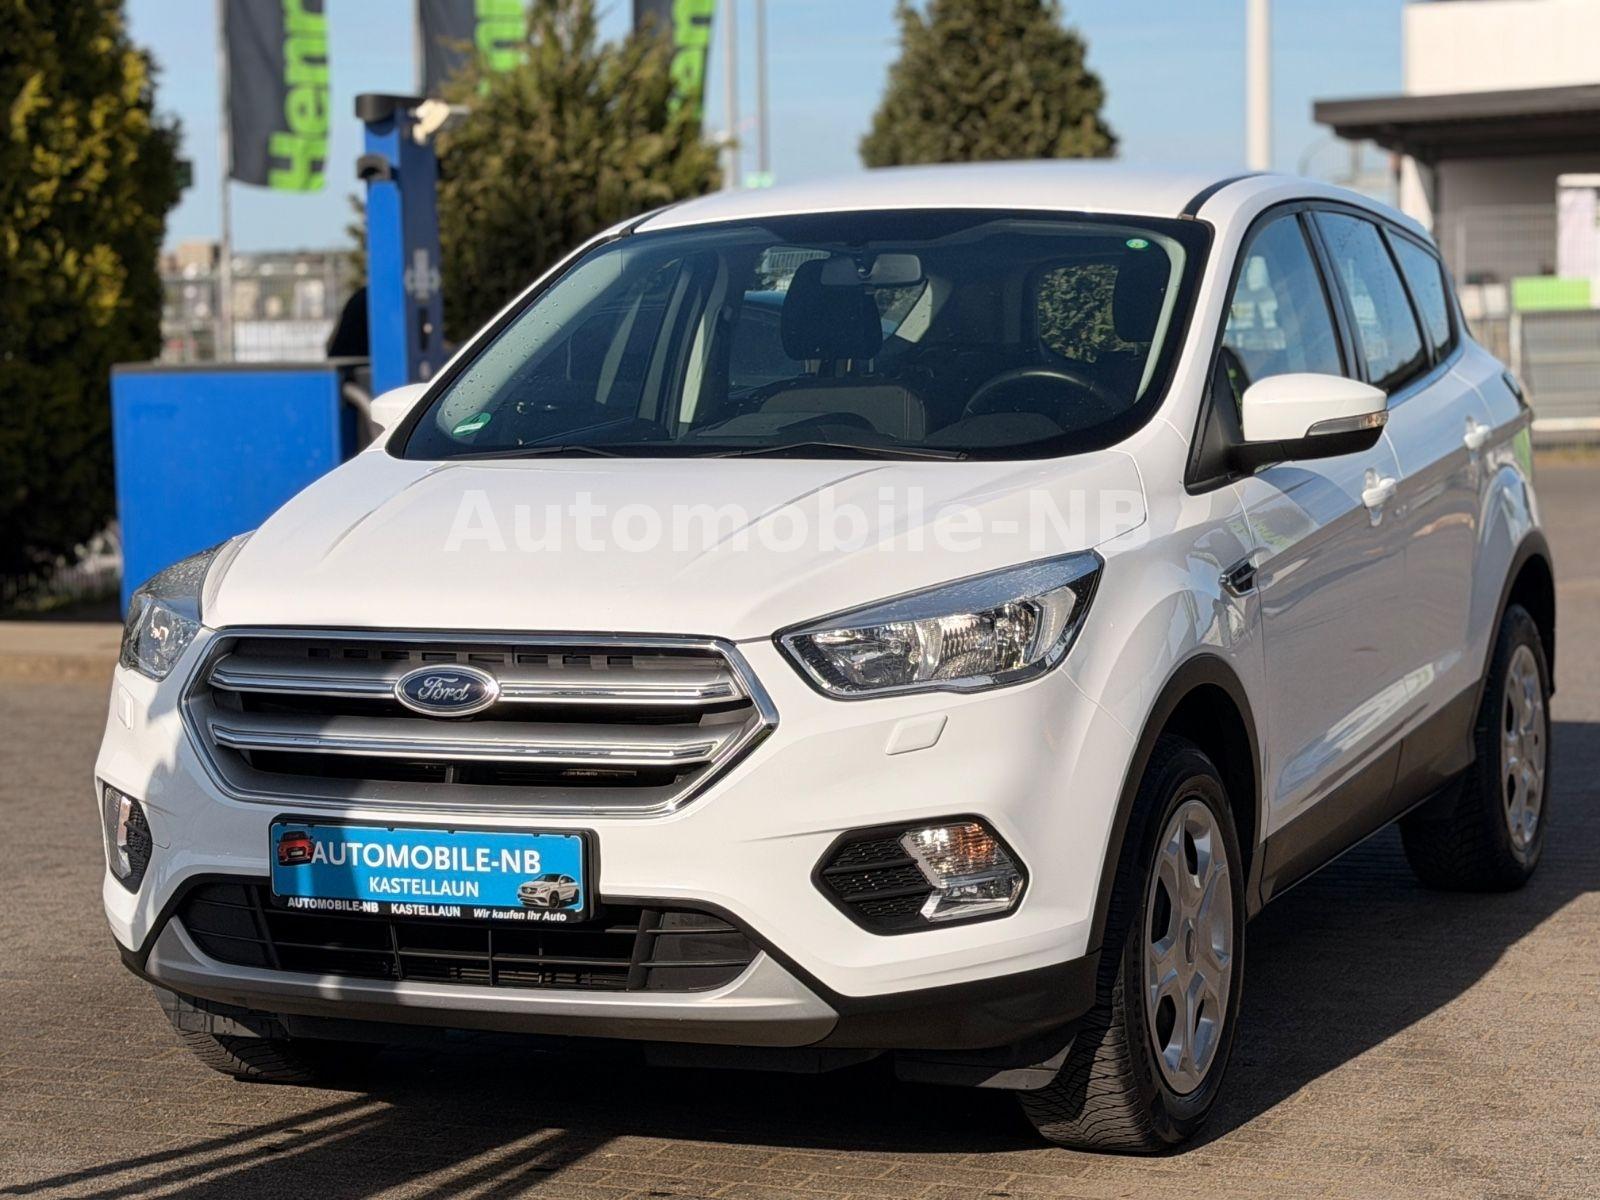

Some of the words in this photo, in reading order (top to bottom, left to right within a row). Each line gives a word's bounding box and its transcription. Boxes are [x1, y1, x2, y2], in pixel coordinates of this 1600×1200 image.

[418, 676, 471, 701] Ford
[311, 841, 541, 874] AUTOMOBILE-NB
[369, 876, 479, 898] KASTELLAUN
[288, 897, 379, 913] AUTOMOBILE-NB
[391, 903, 461, 917] KASTELLAUN
[473, 908, 489, 918] Wir
[491, 909, 525, 920] kaufen
[527, 910, 542, 920] Ihr
[542, 911, 567, 921] Auto
